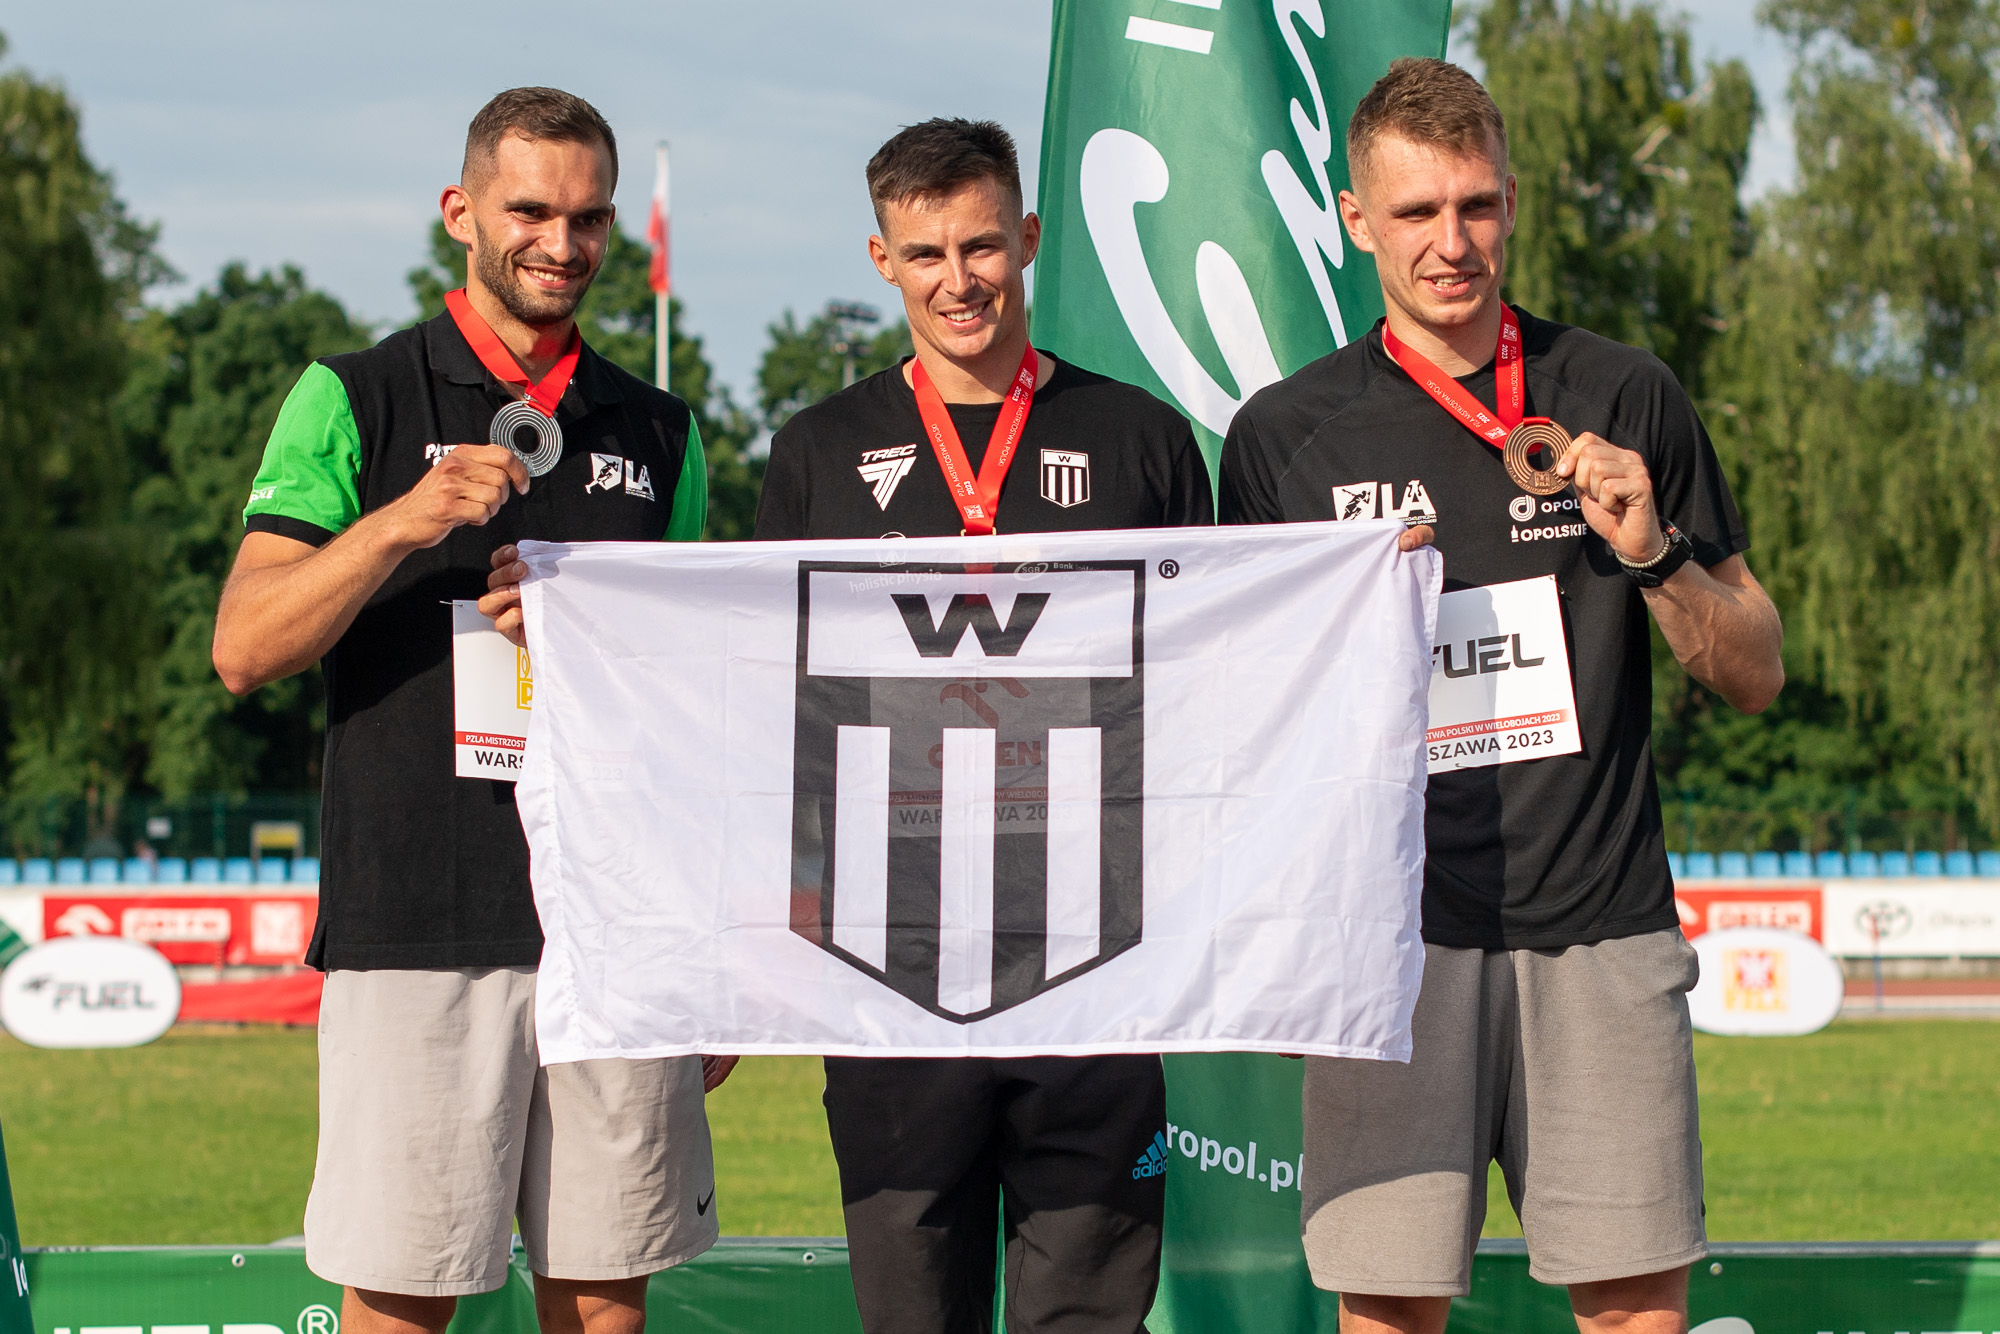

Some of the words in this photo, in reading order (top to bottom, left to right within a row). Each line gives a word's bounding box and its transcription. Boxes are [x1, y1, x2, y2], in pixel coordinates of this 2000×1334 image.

[862, 444, 917, 463] TREC
[1058, 455, 1071, 463] W
[1520, 524, 1588, 542] OPOLSKIE
[890, 592, 1052, 657] W
[1446, 725, 1474, 737] POLSKI
[1475, 723, 1484, 732] W
[1484, 716, 1541, 731] WIELOBOJACH
[1541, 713, 1561, 723] 2023
[465, 734, 485, 744] PZLA
[485, 736, 526, 748] MISTRZOST
[1426, 736, 1501, 763] SZAWA
[1506, 729, 1554, 750] 2023
